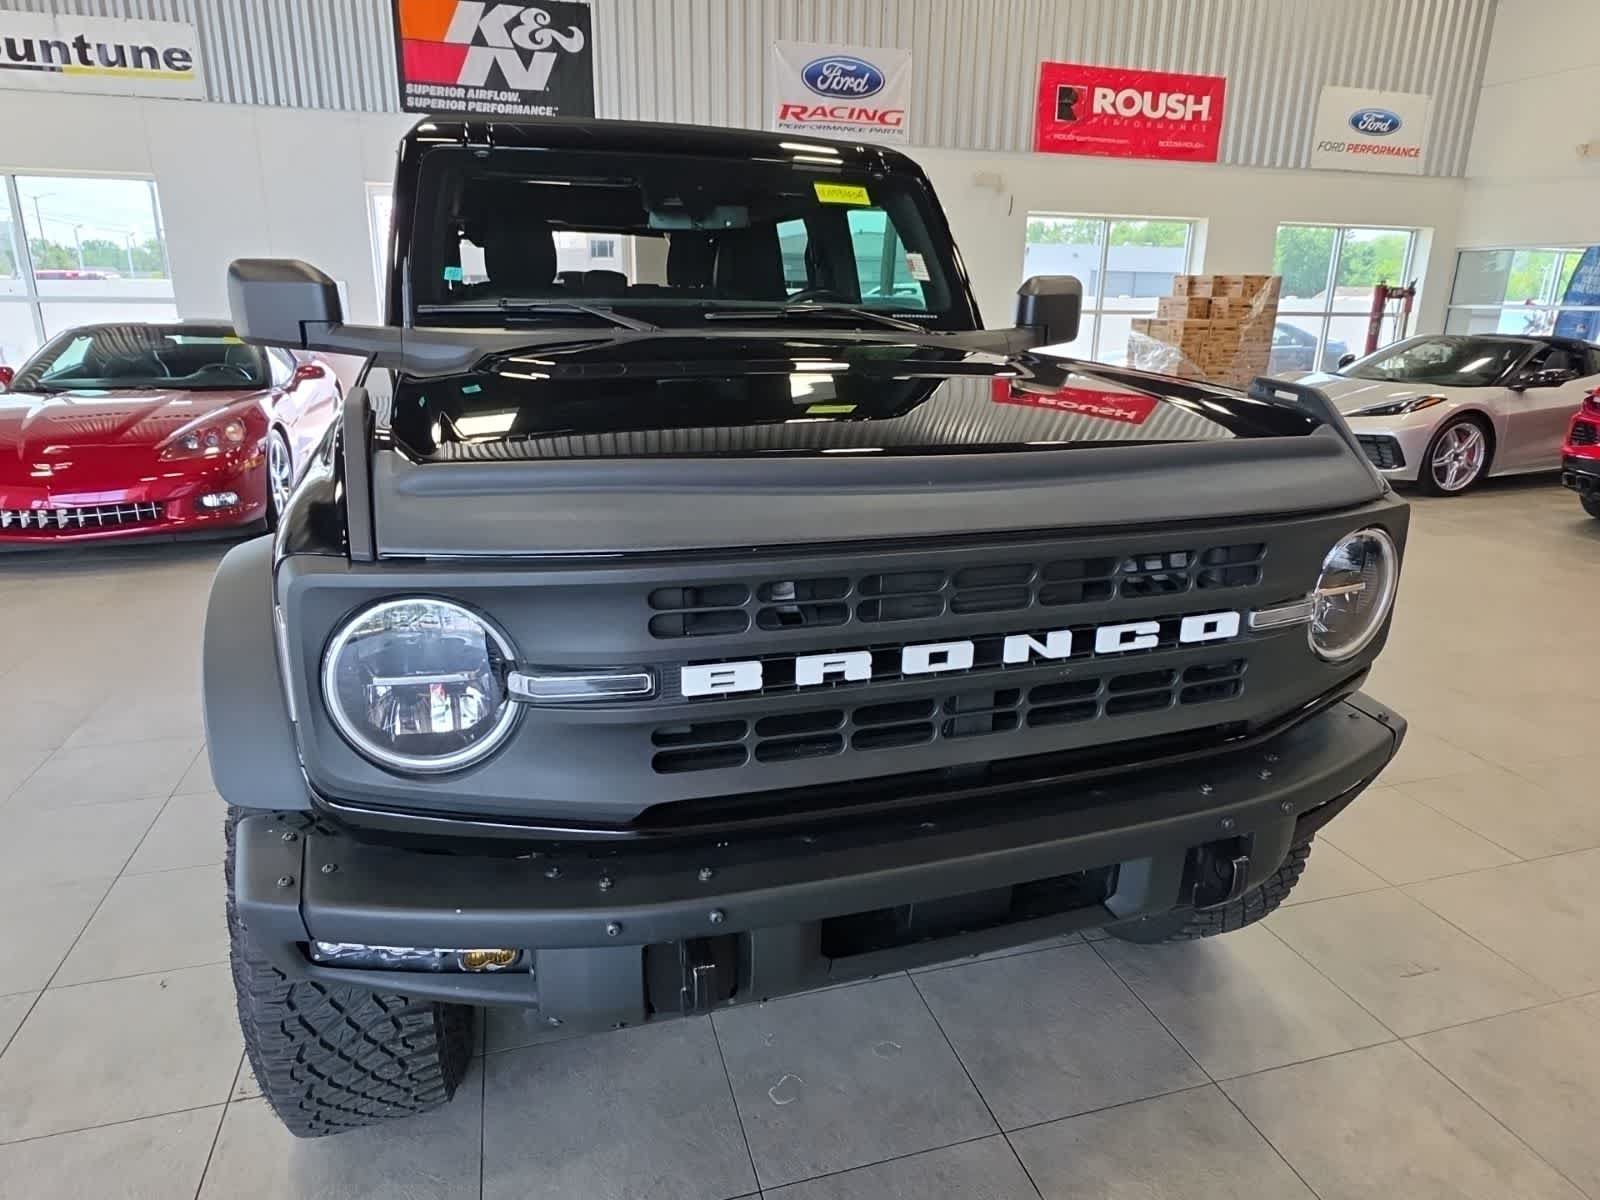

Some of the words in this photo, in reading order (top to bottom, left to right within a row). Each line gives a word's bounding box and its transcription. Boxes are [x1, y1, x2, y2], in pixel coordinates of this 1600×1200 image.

[0, 34, 193, 71] untune
[444, 1, 585, 91] K&N
[816, 62, 870, 93] Ford
[405, 83, 466, 98] SUPERIOR
[467, 88, 521, 103] AIRFLOW.
[406, 96, 466, 111] SUPERIOR
[1093, 87, 1211, 121] ROUSH
[779, 104, 904, 126] RACING
[1358, 112, 1393, 132] Ford
[869, 127, 904, 135] PARTS
[1317, 140, 1345, 152] FORD
[1346, 143, 1421, 158] PERFORMANCE
[681, 611, 1240, 697] BRONCO
